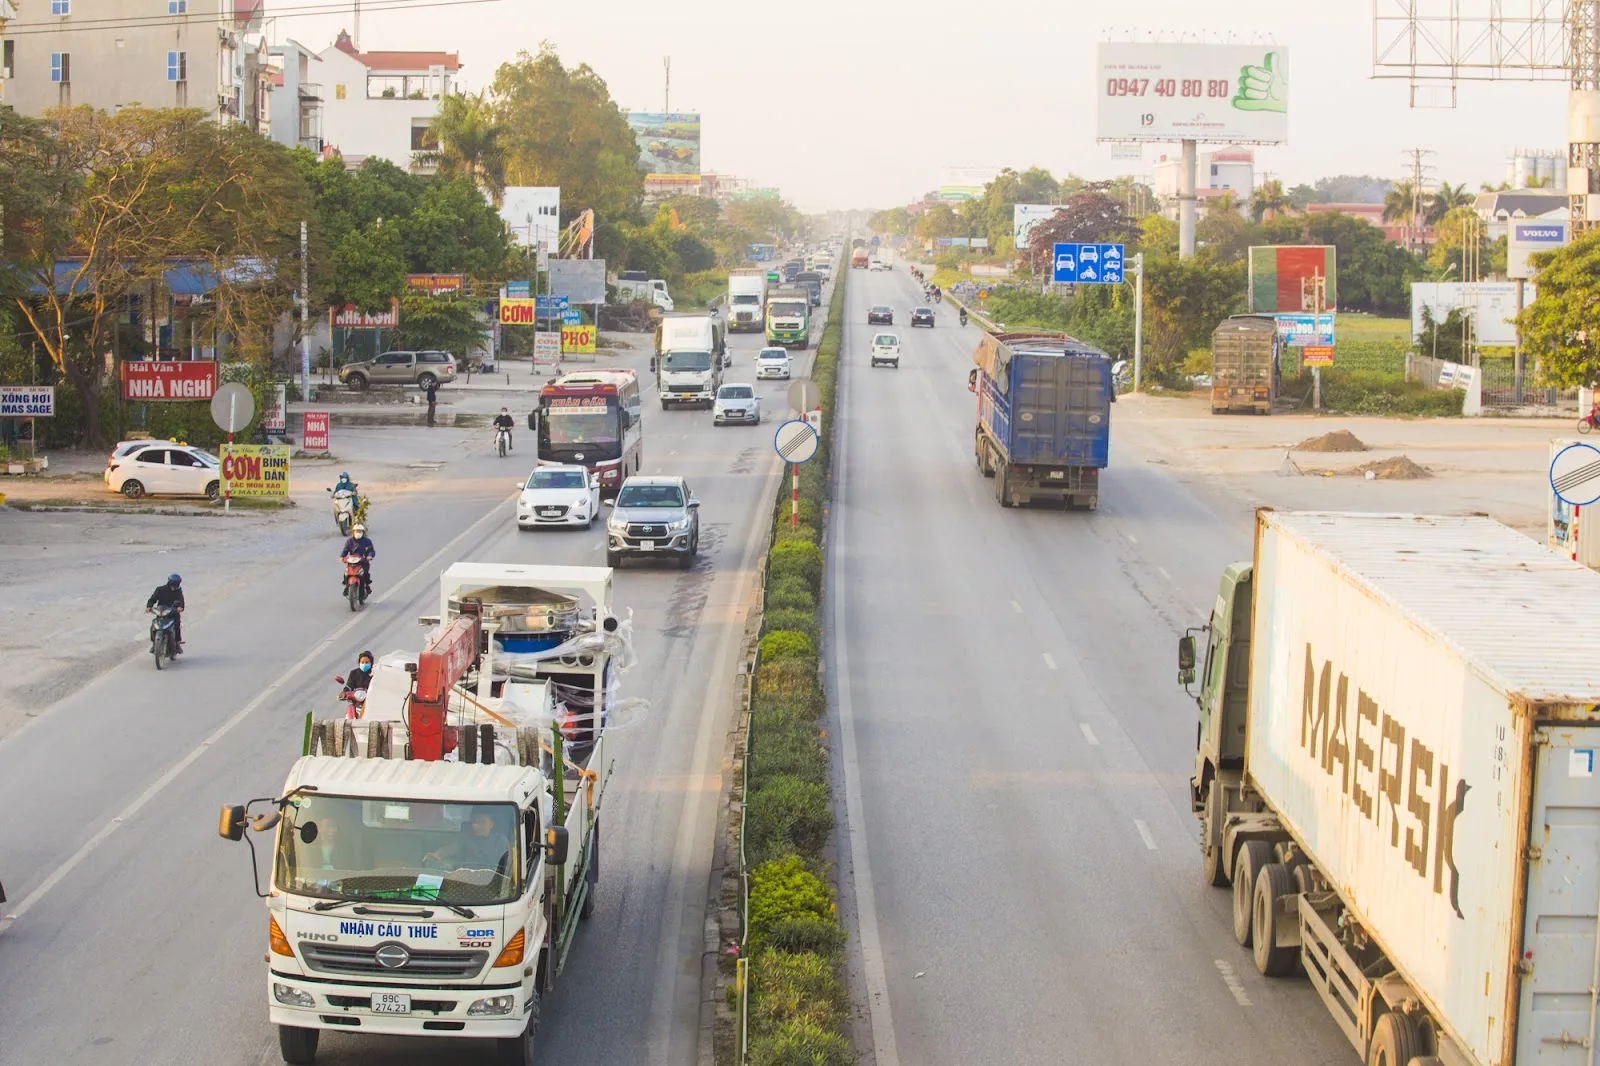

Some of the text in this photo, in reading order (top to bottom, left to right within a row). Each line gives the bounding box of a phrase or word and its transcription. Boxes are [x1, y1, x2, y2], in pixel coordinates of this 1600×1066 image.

[1107, 78, 1229, 97] 0947 40 80 80
[1141, 113, 1154, 126] 19
[501, 304, 533, 322] CƠM
[561, 326, 590, 346] PHỞ
[177, 363, 182, 372] 1
[129, 374, 212, 397] NHÀ NGHỈ
[2, 392, 50, 403] XÔNG HƠI
[551, 397, 580, 407] XUÂN
[2, 405, 51, 413] MAS SAGE
[307, 420, 325, 431] NHÀ
[305, 434, 327, 446] NGHỈ
[223, 454, 287, 480] CƠM BÌNH
[264, 469, 285, 480] DÂN
[1301, 642, 1472, 920] MAERSK
[340, 920, 374, 937] NHẬN
[408, 924, 438, 938] THUÊ
[466, 929, 494, 937] QDR
[297, 931, 338, 942] HINO
[382, 994, 399, 1003] 89C
[375, 1003, 406, 1012] 274.23
